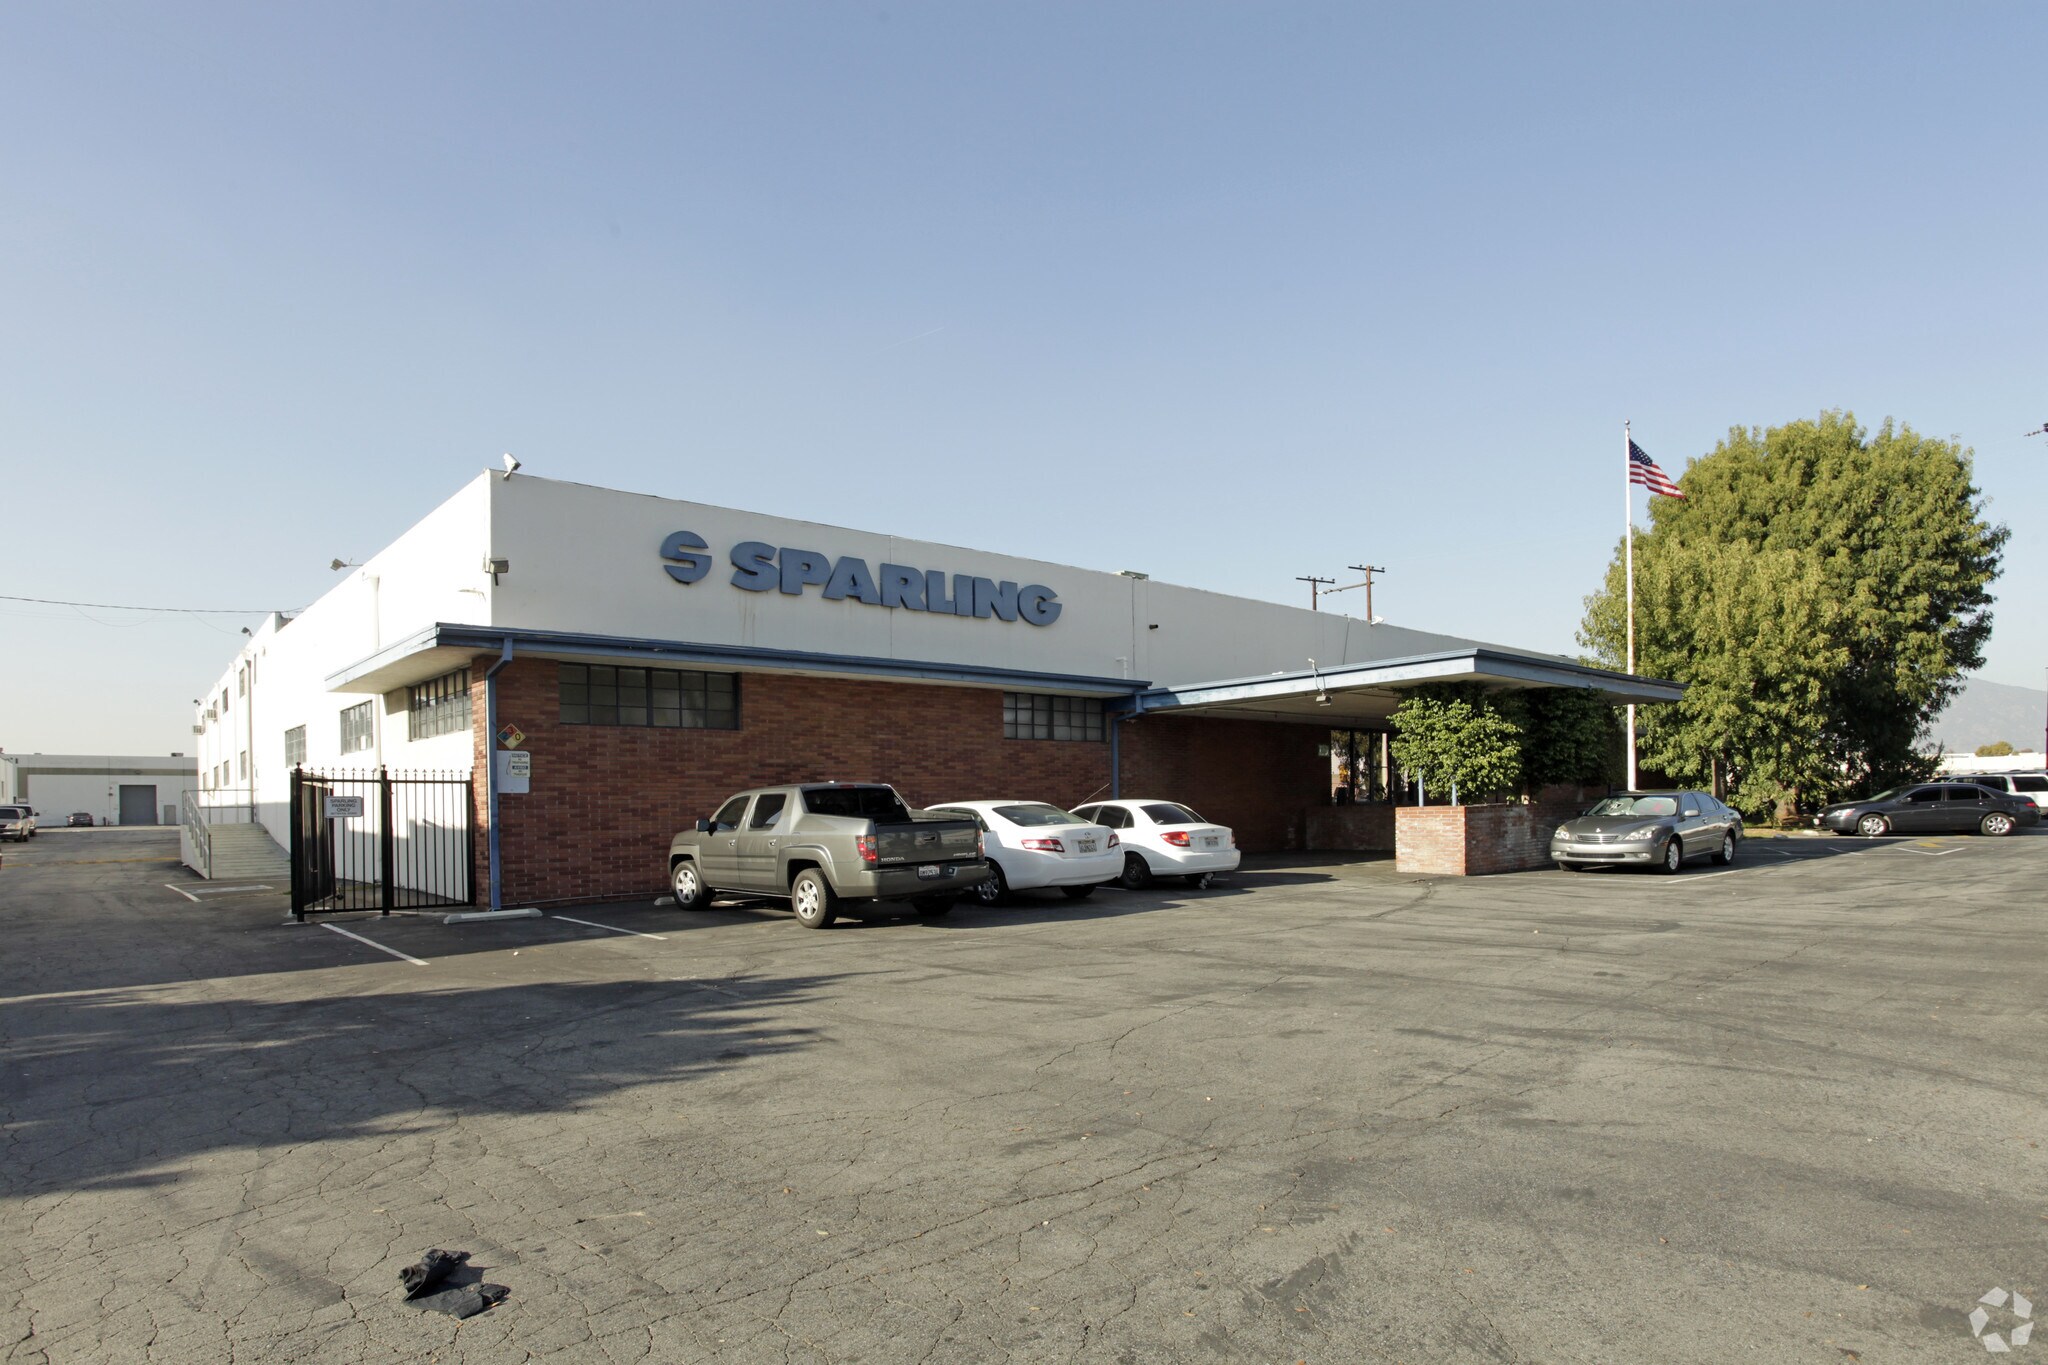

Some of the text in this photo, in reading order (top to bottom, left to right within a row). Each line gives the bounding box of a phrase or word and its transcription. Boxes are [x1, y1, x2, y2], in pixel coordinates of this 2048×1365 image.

[660, 530, 1063, 627] S SPARLING
[515, 733, 521, 741] 0
